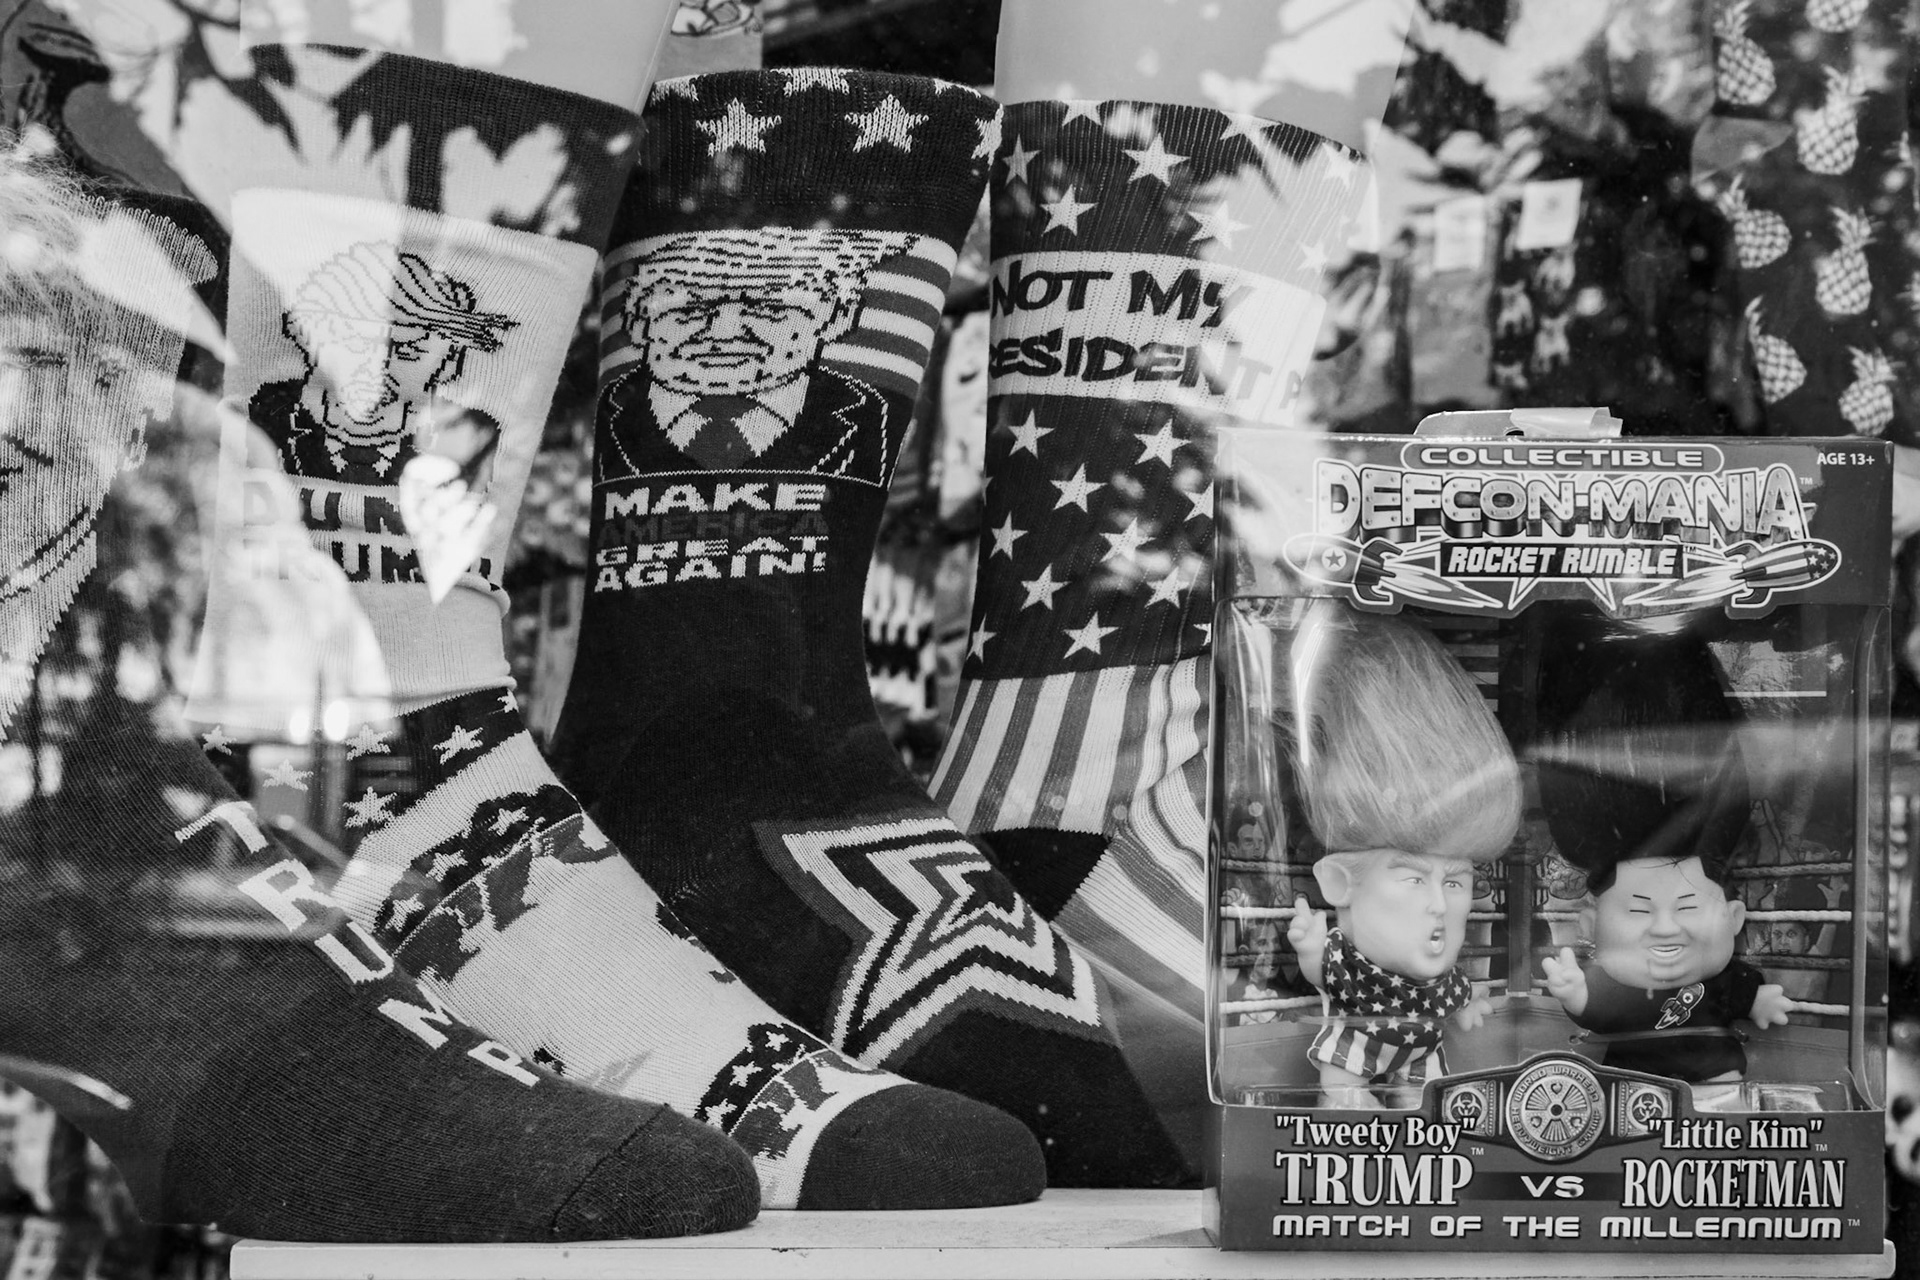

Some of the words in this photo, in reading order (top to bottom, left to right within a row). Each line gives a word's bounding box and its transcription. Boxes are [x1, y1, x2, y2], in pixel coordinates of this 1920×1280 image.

[991, 259, 1113, 319] NOT
[1127, 267, 1255, 328] MY
[1420, 447, 1703, 467] COLLECTIBLE
[1816, 452, 1846, 466] AGE
[1849, 453, 1875, 466] 13+
[604, 483, 827, 520] MAKE
[1314, 460, 1807, 544] DEFCON-MANIA
[598, 511, 829, 546] AMERICA
[595, 536, 829, 567] GREAT
[1448, 546, 1556, 574] ROCKET
[1561, 547, 1677, 575] RUMBLE
[594, 552, 827, 593] AGAIN!
[175, 800, 541, 1088] TRUMP
[1275, 1115, 1398, 1153] "Tweety
[1405, 1116, 1476, 1153] Boy"
[1649, 1118, 1742, 1150] "Little
[1748, 1119, 1823, 1149] Kim"
[1275, 1151, 1474, 1206] TRUMP
[1621, 1158, 1846, 1209] ROCKETMAN
[1272, 1214, 1410, 1237] MATCH
[1429, 1215, 1482, 1237] OF
[1502, 1215, 1580, 1238] THE
[1599, 1216, 1842, 1239] MILLENNIUM
